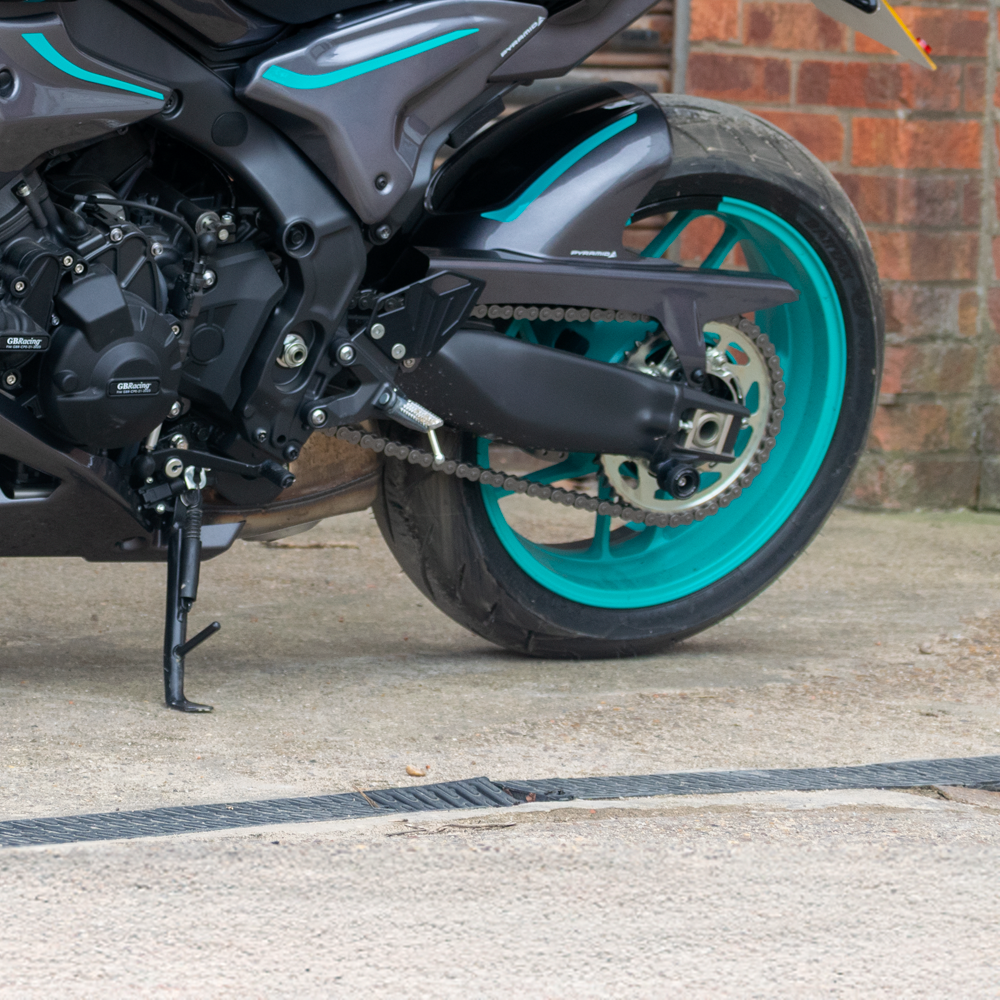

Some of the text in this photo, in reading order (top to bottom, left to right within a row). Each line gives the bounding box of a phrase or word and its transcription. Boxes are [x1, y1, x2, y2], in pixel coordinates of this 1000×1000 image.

[500, 19, 539, 58] PYRAMID
[6, 337, 42, 346] GBRacing
[116, 382, 152, 391] GBRacing
